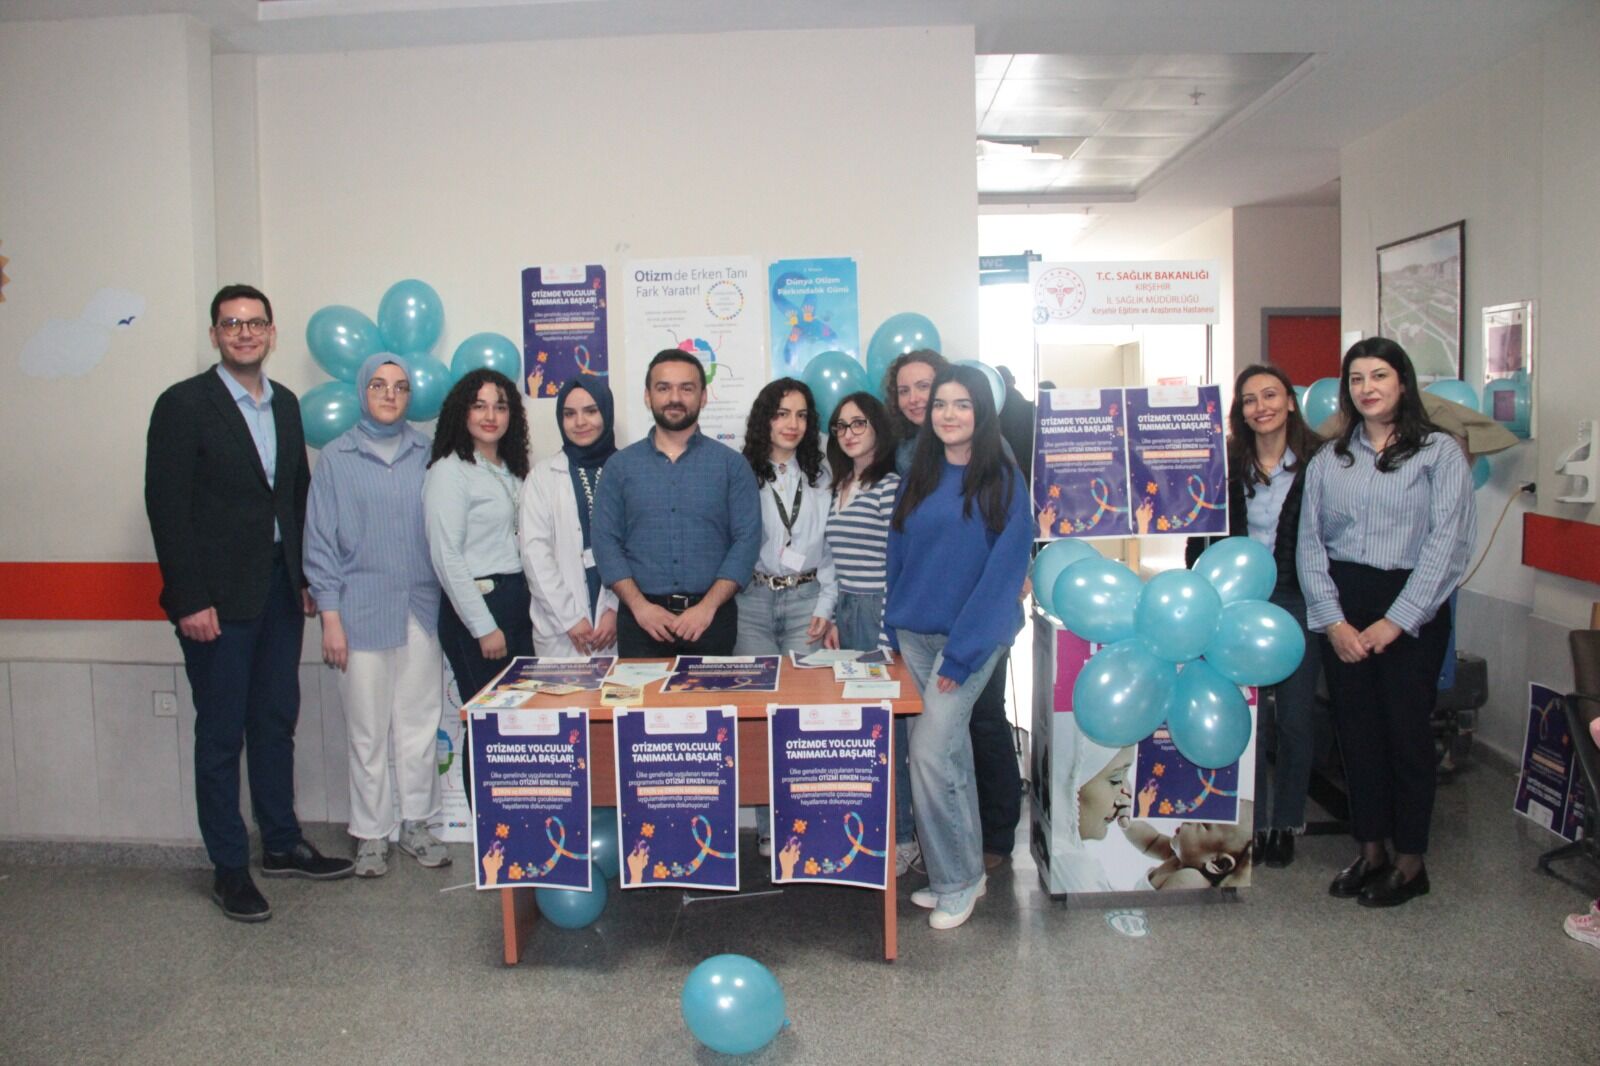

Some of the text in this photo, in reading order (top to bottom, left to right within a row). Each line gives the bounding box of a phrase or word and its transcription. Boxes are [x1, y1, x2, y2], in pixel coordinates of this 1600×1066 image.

[983, 259, 1003, 268] WC
[691, 269, 722, 280] Erken
[725, 267, 748, 279] Tanı
[1096, 269, 1209, 280] T.C. SAĞLIK BAKANLIĞI
[786, 278, 813, 286] Dünya
[532, 289, 596, 298] OTİZMDE YOLCULUK
[636, 285, 700, 298] Fark Yaratır!
[532, 296, 597, 306] TANIMAKLA BAŞLAR!
[1116, 294, 1145, 304] SAĞLIK
[1146, 294, 1200, 304] MÜDÜRLÜĞÜ
[1150, 306, 1182, 314] Araştırma
[1041, 416, 1113, 426] OTİZMDE YOLCULUK
[1138, 413, 1210, 422] OTİZMDE YOLCULUK
[1041, 425, 1114, 434] TANIMAKLA BAŞLAR!
[1138, 422, 1211, 431] TANIMAKLA BAŞLAR!
[486, 742, 574, 753] OTİZMDE YOLCULUK
[632, 741, 721, 752] OTİZMDE YOLCULUK
[786, 738, 876, 749] OTİZMDE YOLCULUK
[486, 754, 574, 765] TANIMAKLA BAŞLAR!
[632, 752, 722, 763] TANIMAKLA BAŞLAR!
[786, 749, 876, 760] TANIMAKLA BAŞLAR!
